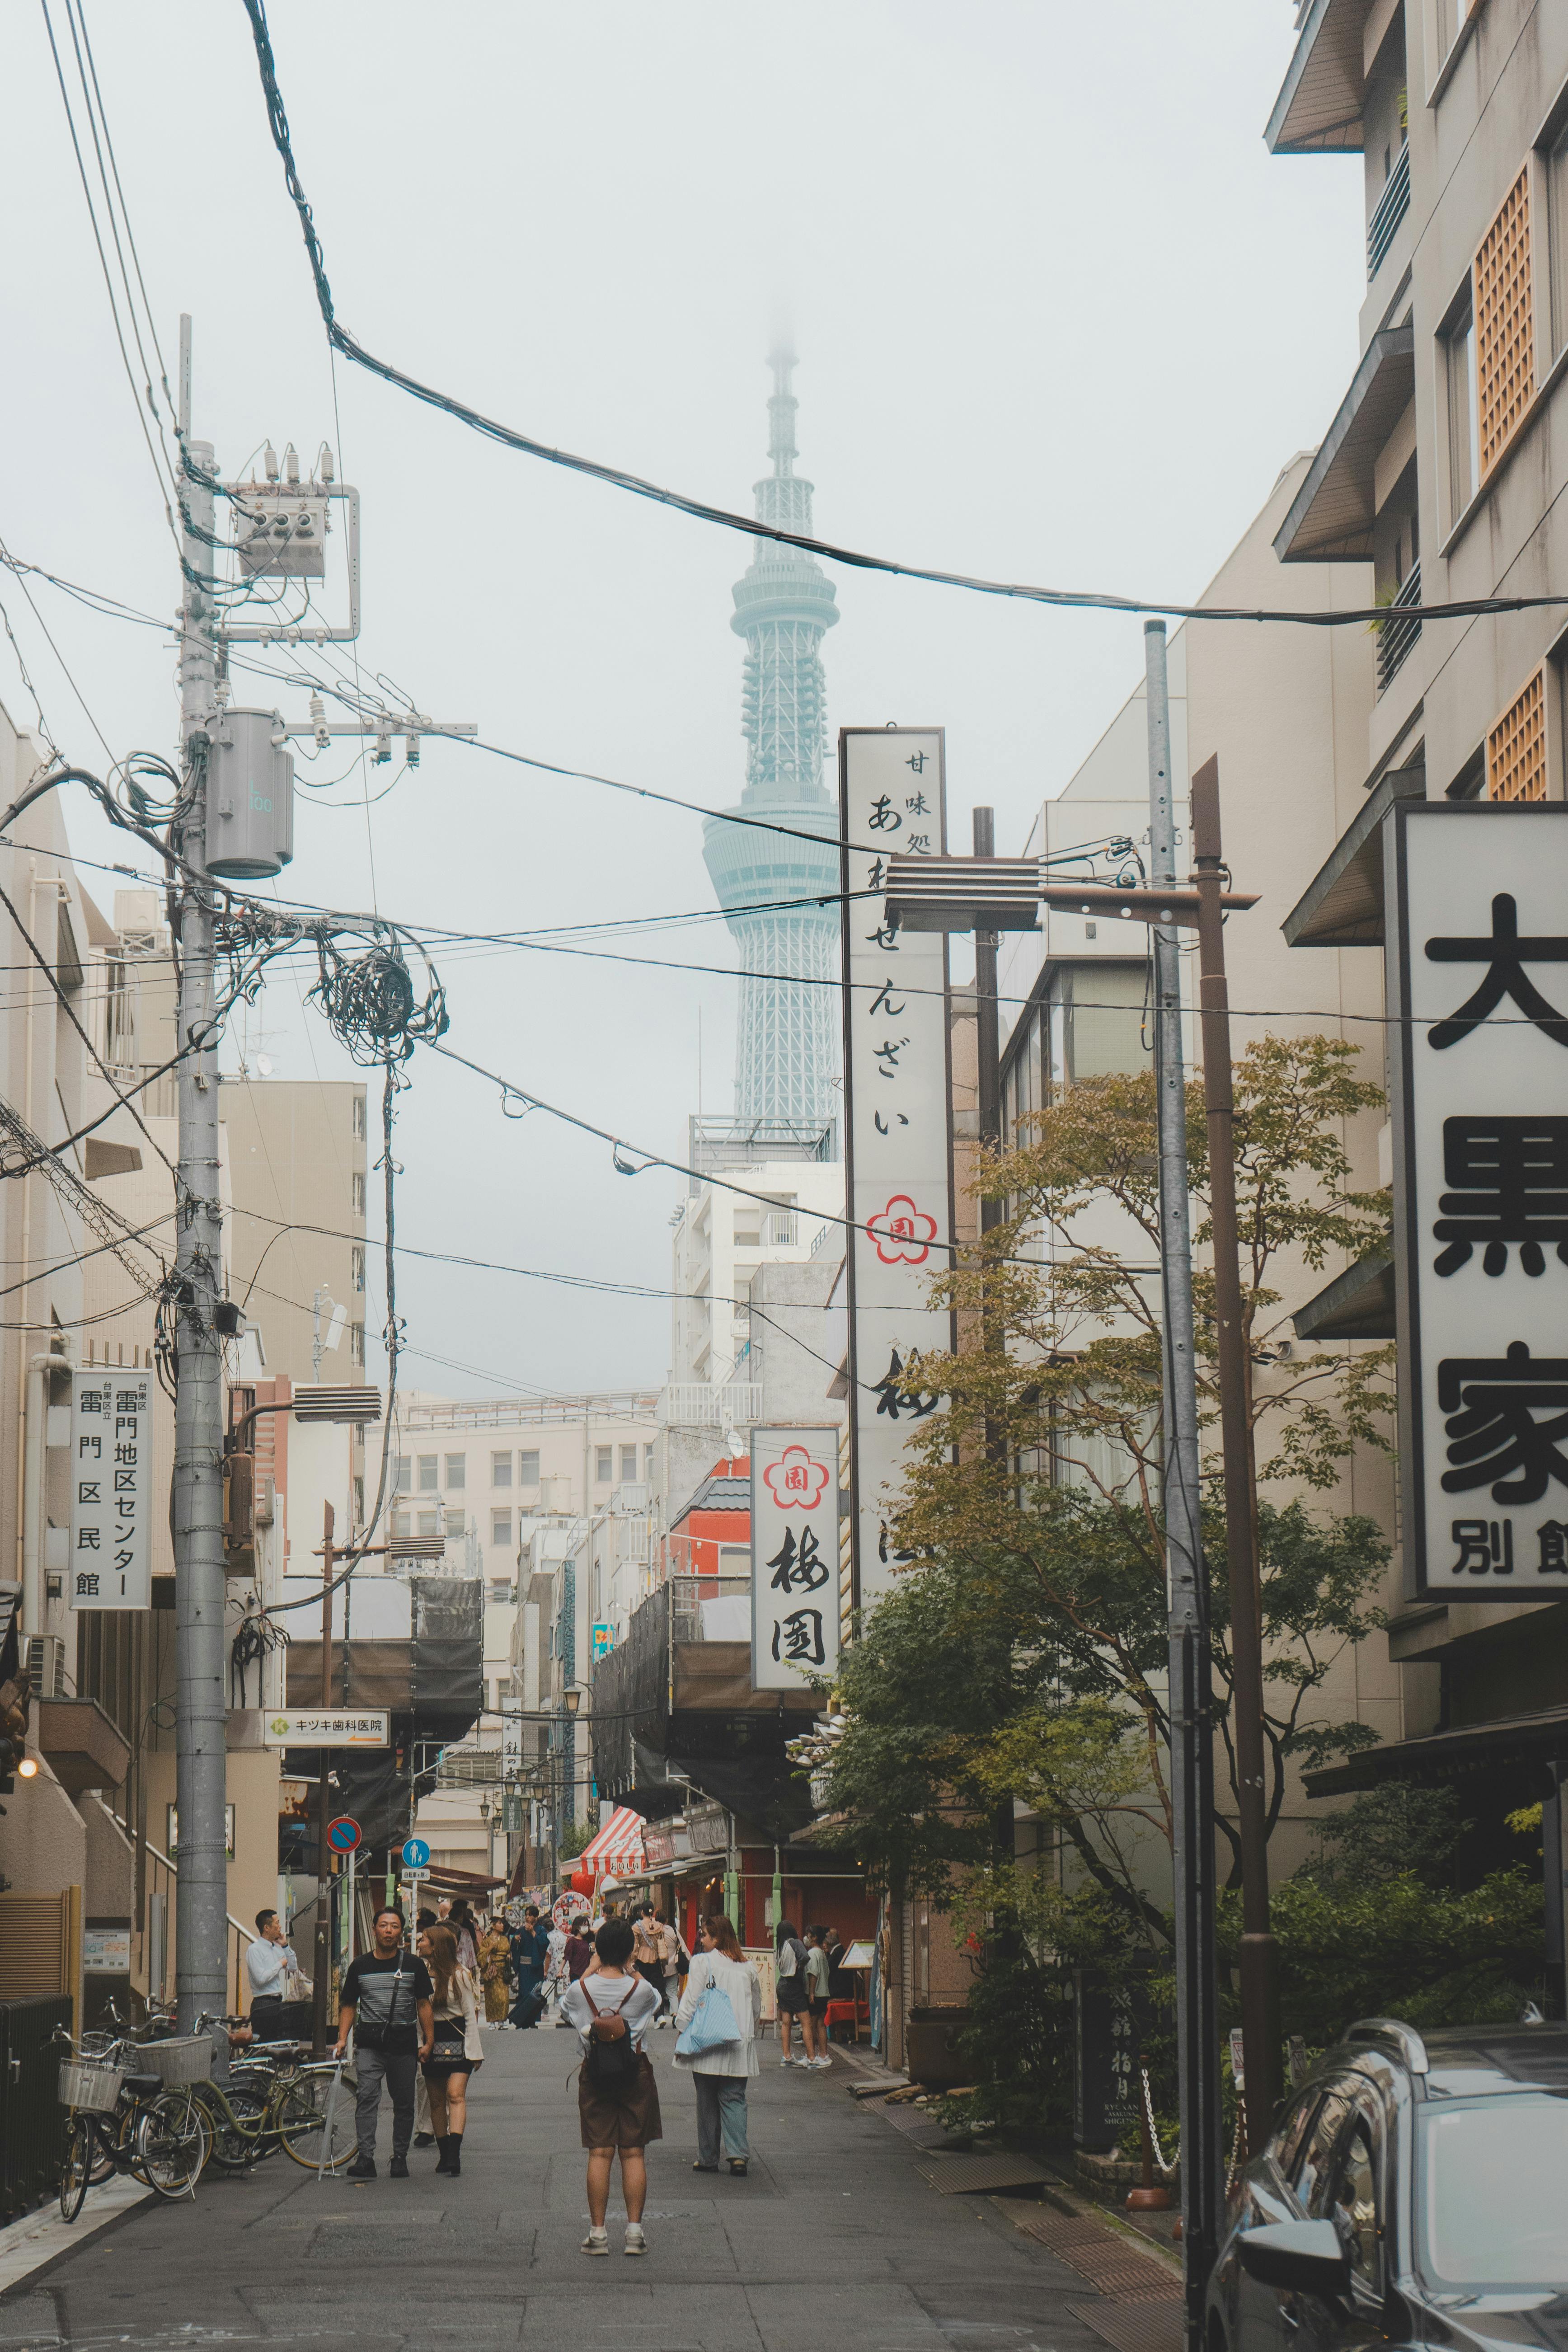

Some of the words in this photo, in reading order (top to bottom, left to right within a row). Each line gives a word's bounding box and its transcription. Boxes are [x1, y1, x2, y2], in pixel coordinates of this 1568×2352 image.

[249, 795, 272, 812] 100
[905, 750, 931, 855] 甘味処
[1425, 893, 1568, 1504] 大黒家
[103, 1381, 112, 1420] 台東区立
[138, 1382, 147, 1410] 台東区
[76, 1390, 103, 1596] 雷門区民館
[114, 1390, 137, 1596] 雷門地区センター
[610, 1861, 639, 1871] おいしい
